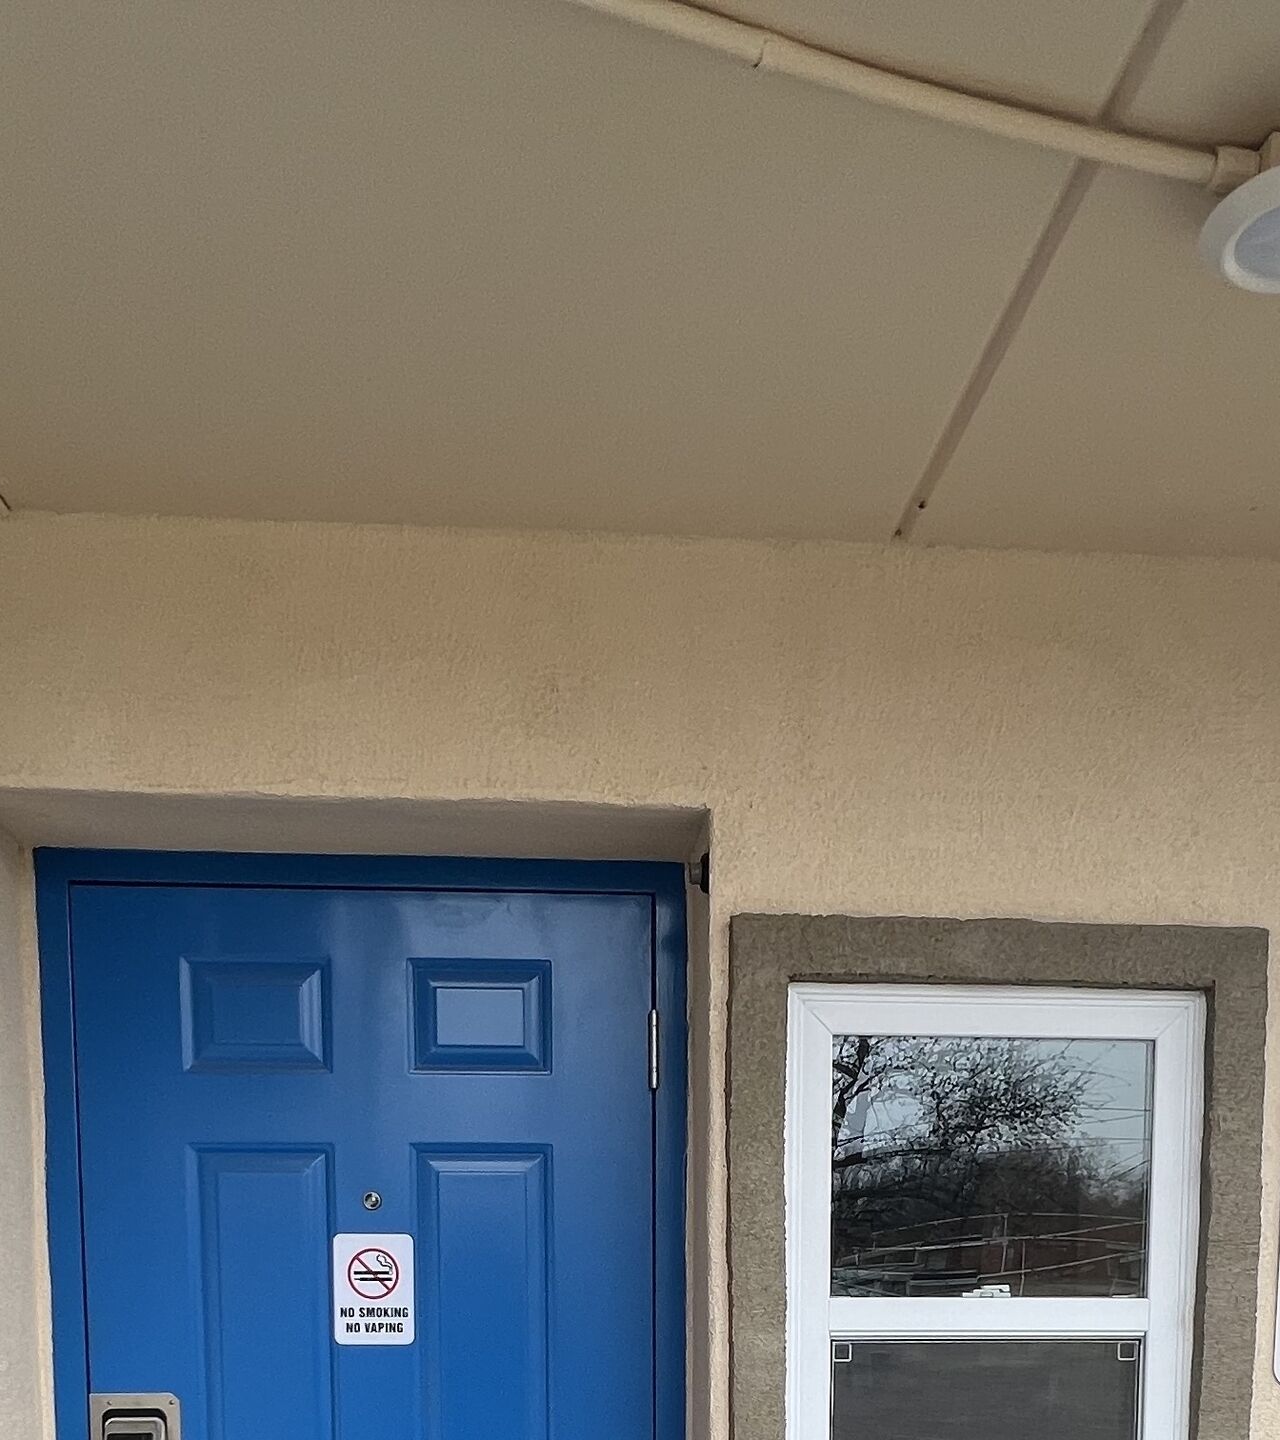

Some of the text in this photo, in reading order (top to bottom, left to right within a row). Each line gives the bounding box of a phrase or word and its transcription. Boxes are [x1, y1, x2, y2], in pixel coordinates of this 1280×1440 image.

[340, 1307, 409, 1318] NO SMOKING
[346, 1322, 404, 1333] NO VAPING
